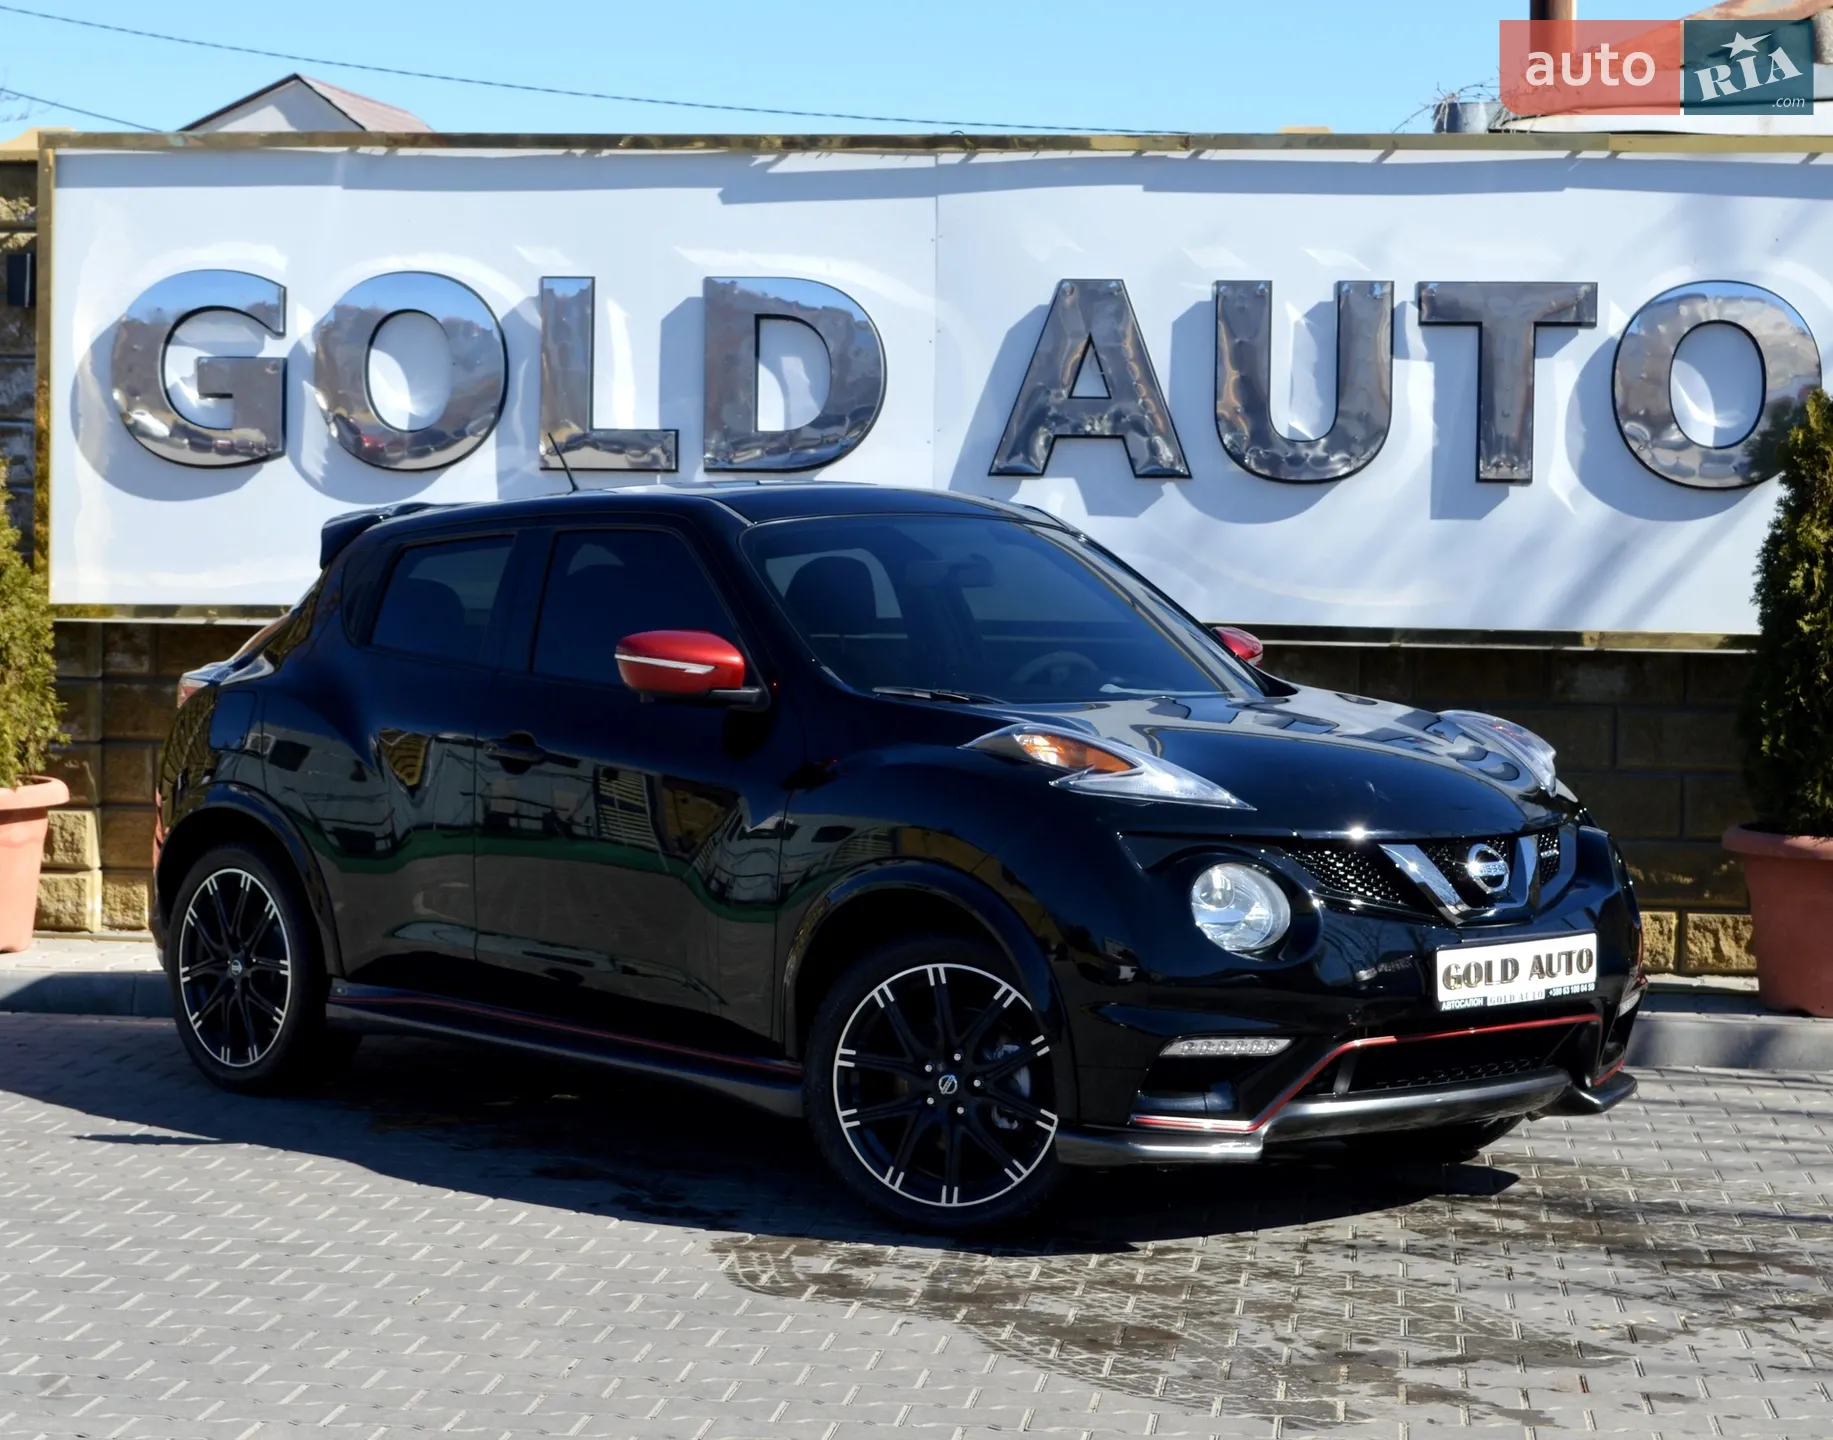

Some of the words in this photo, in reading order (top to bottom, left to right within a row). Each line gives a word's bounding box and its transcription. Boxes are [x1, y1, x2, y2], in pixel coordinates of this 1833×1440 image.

[111, 268, 888, 474] GOLD
[988, 278, 1823, 491] AUTO
[1442, 957, 1520, 991] GOLD
[1529, 947, 1594, 981] AUTO
[1441, 998, 1484, 1011] АВТОСАЛОН
[1489, 993, 1515, 1005] GOLD
